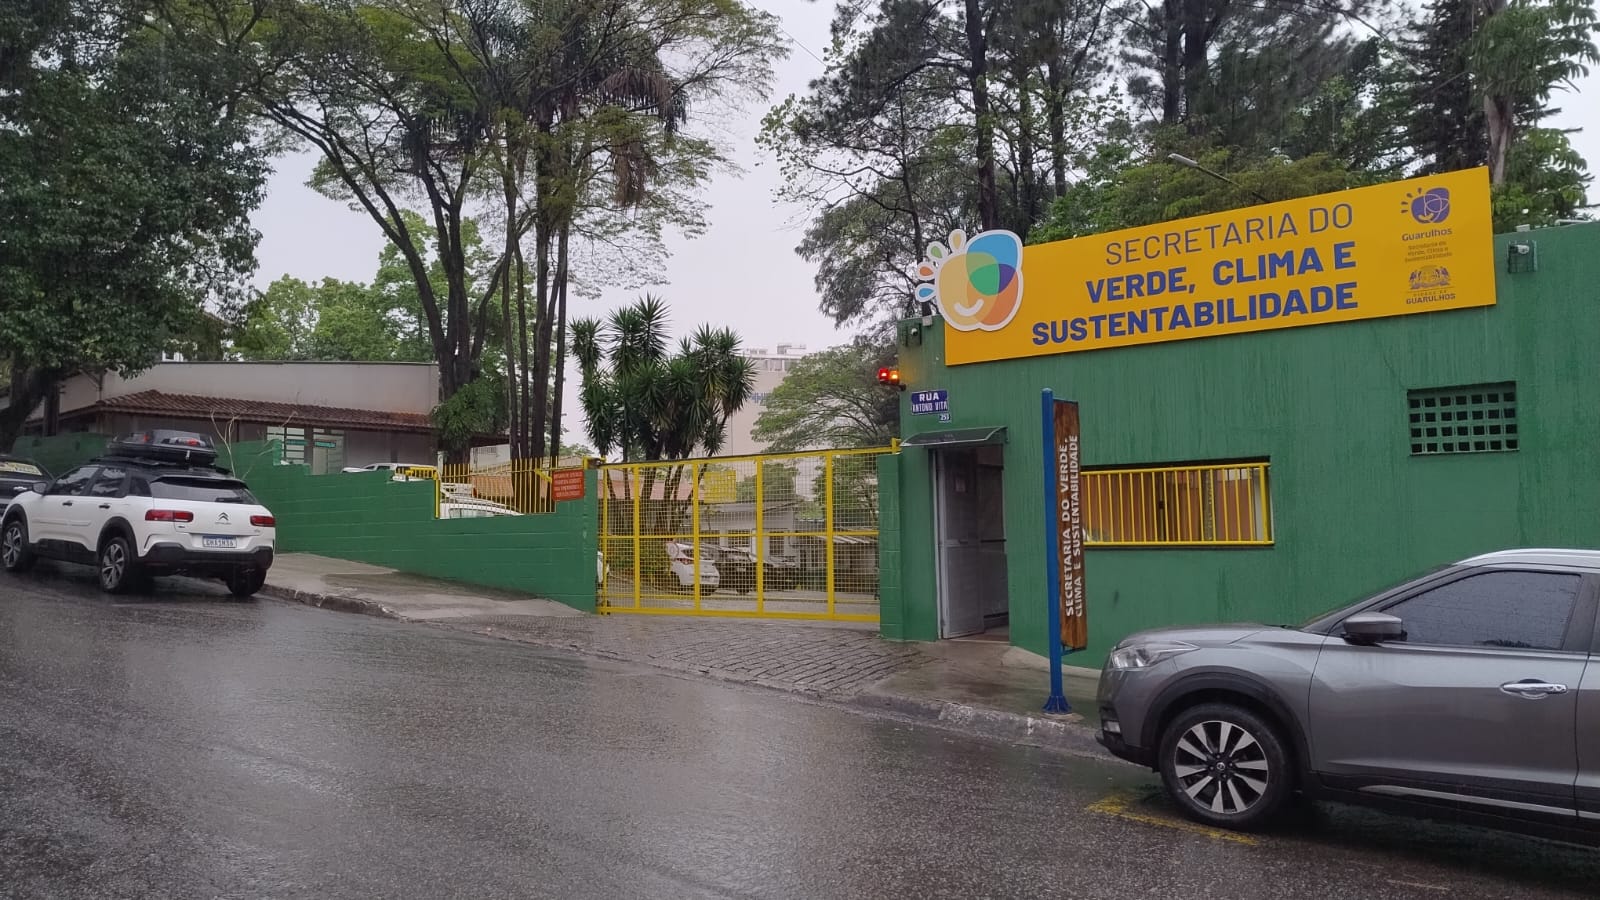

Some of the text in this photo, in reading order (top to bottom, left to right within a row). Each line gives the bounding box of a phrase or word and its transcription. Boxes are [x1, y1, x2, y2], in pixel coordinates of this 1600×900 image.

[1106, 203, 1353, 265] SECRETARIA DO
[1402, 228, 1453, 241] Guarulhos
[1086, 241, 1357, 304] VERDE, CLIMA E
[1406, 293, 1456, 304] GUARULHOS
[1031, 282, 1359, 346] SUSTENTABILIDADE
[919, 392, 940, 402] RUA
[1059, 438, 1074, 617] SECRETARIA DO VERDE,
[1069, 434, 1083, 618] CLIMA E SUSTENTABILIDADE
